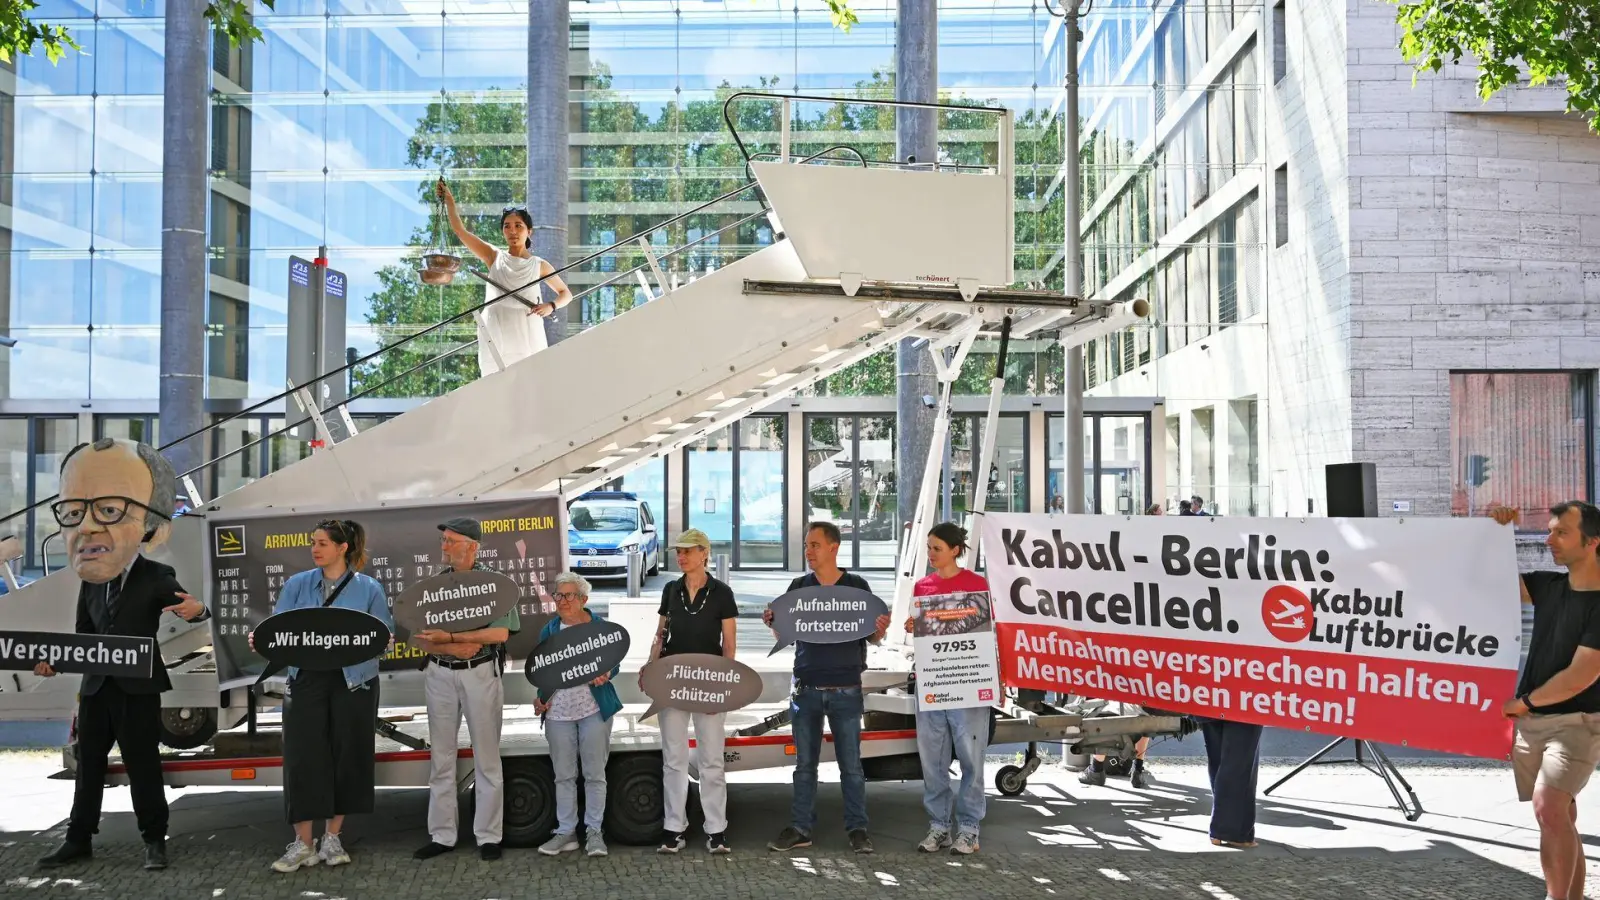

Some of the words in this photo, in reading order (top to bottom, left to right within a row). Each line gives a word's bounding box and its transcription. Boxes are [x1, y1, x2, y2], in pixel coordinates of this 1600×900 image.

[481, 518, 516, 534] IRPORT
[518, 516, 554, 531] BERLIN
[1001, 528, 1126, 572] Kabul
[1160, 534, 1335, 582] Berlin:
[218, 568, 240, 578] FLIGHT
[266, 564, 284, 574] FROM
[372, 558, 388, 566] GATE
[414, 554, 430, 563] TIME
[220, 579, 248, 591] MRL
[221, 593, 248, 605] UBP
[1009, 577, 1239, 633] Cancelled.
[1310, 588, 1404, 618] Kabul
[221, 608, 248, 618] BAP
[220, 624, 248, 635] BAP
[1309, 618, 1499, 657] Luftbrücke
[302, 632, 350, 650] klagen
[932, 640, 976, 653] 97.953
[1014, 629, 1347, 690] Aufnahmeversprechen
[1358, 663, 1493, 711] halten,
[1017, 656, 1231, 707] Menschenleben
[1240, 691, 1356, 726] retten!
